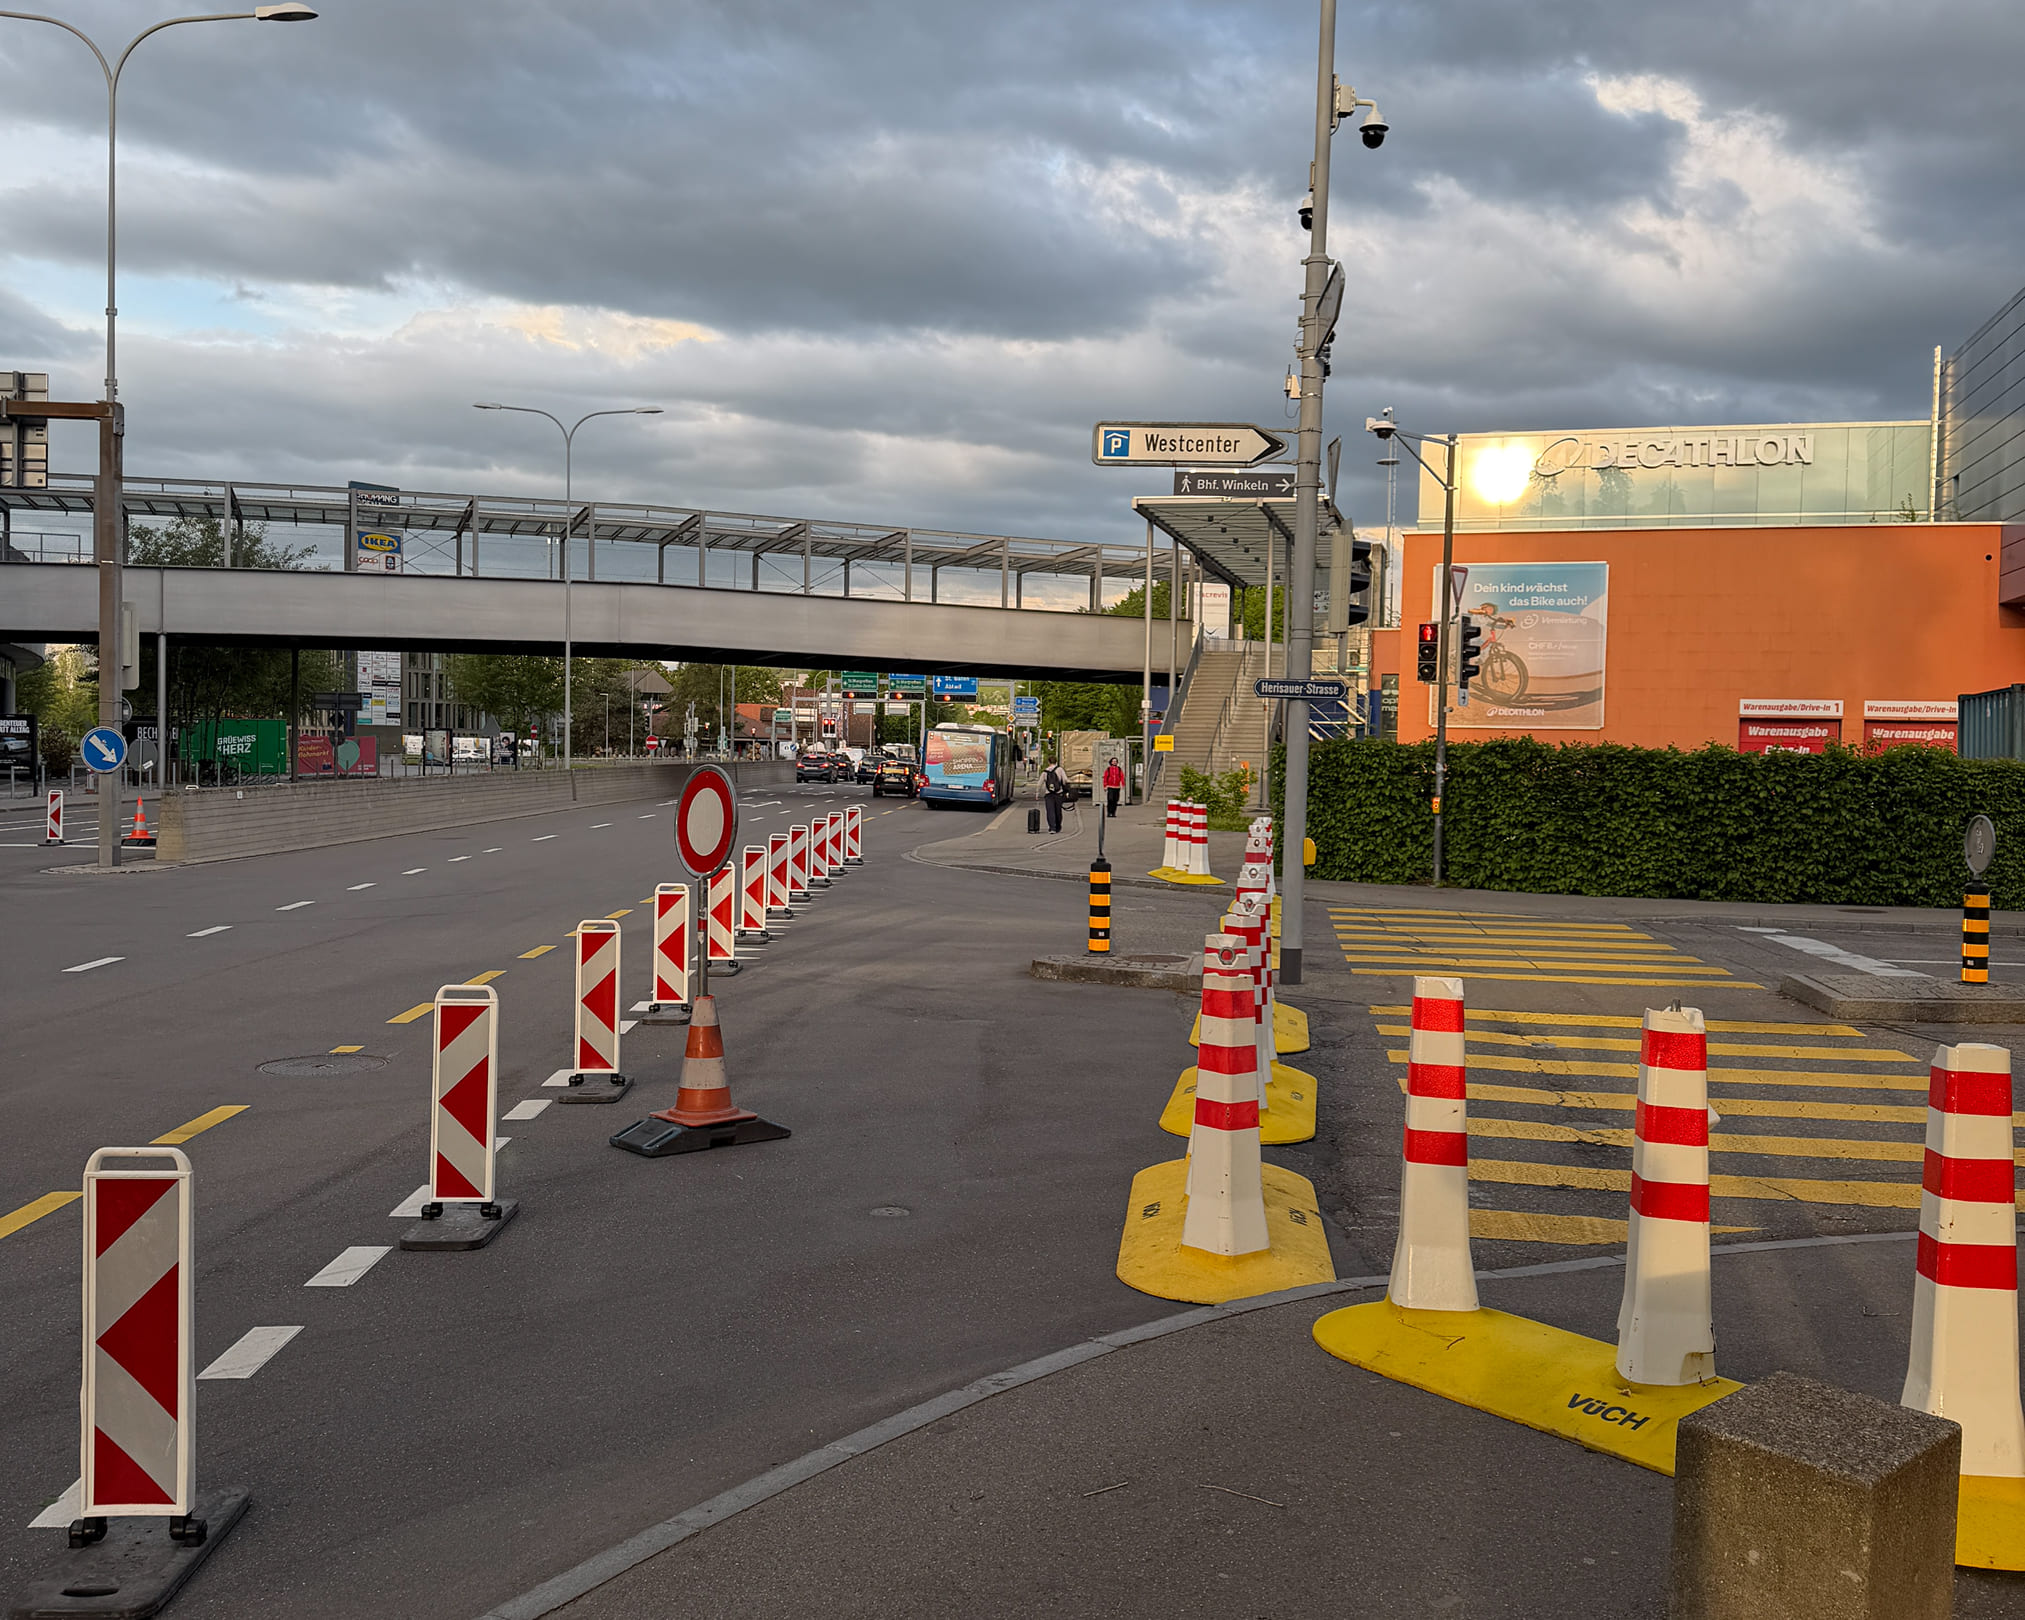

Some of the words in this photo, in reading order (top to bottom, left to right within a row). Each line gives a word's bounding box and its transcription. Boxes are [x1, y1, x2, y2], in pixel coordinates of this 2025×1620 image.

[1144, 433, 1240, 453] Westcenter
[1587, 434, 1813, 468] DECATHLON
[1197, 479, 1219, 491] Bhf.
[1222, 479, 1269, 492] Winkeln
[364, 537, 395, 548] IKEA
[1474, 584, 1498, 592] Dein
[1500, 583, 1524, 593] kind
[1526, 582, 1568, 593] wächst
[1509, 597, 1529, 606] das
[1531, 596, 1555, 606] Bike
[1557, 596, 1587, 606] auch!
[1261, 682, 1339, 695] Herisauer-Strasse
[1743, 703, 1831, 712] Warenausgabe/Drive-In
[1834, 703, 1840, 713] 1
[1867, 704, 1957, 713] Warenausgabe/Drive-In
[1748, 726, 1828, 738] Warenausgabe
[1872, 728, 1955, 740] Warenausgabe
[222, 743, 252, 755] HERZ
